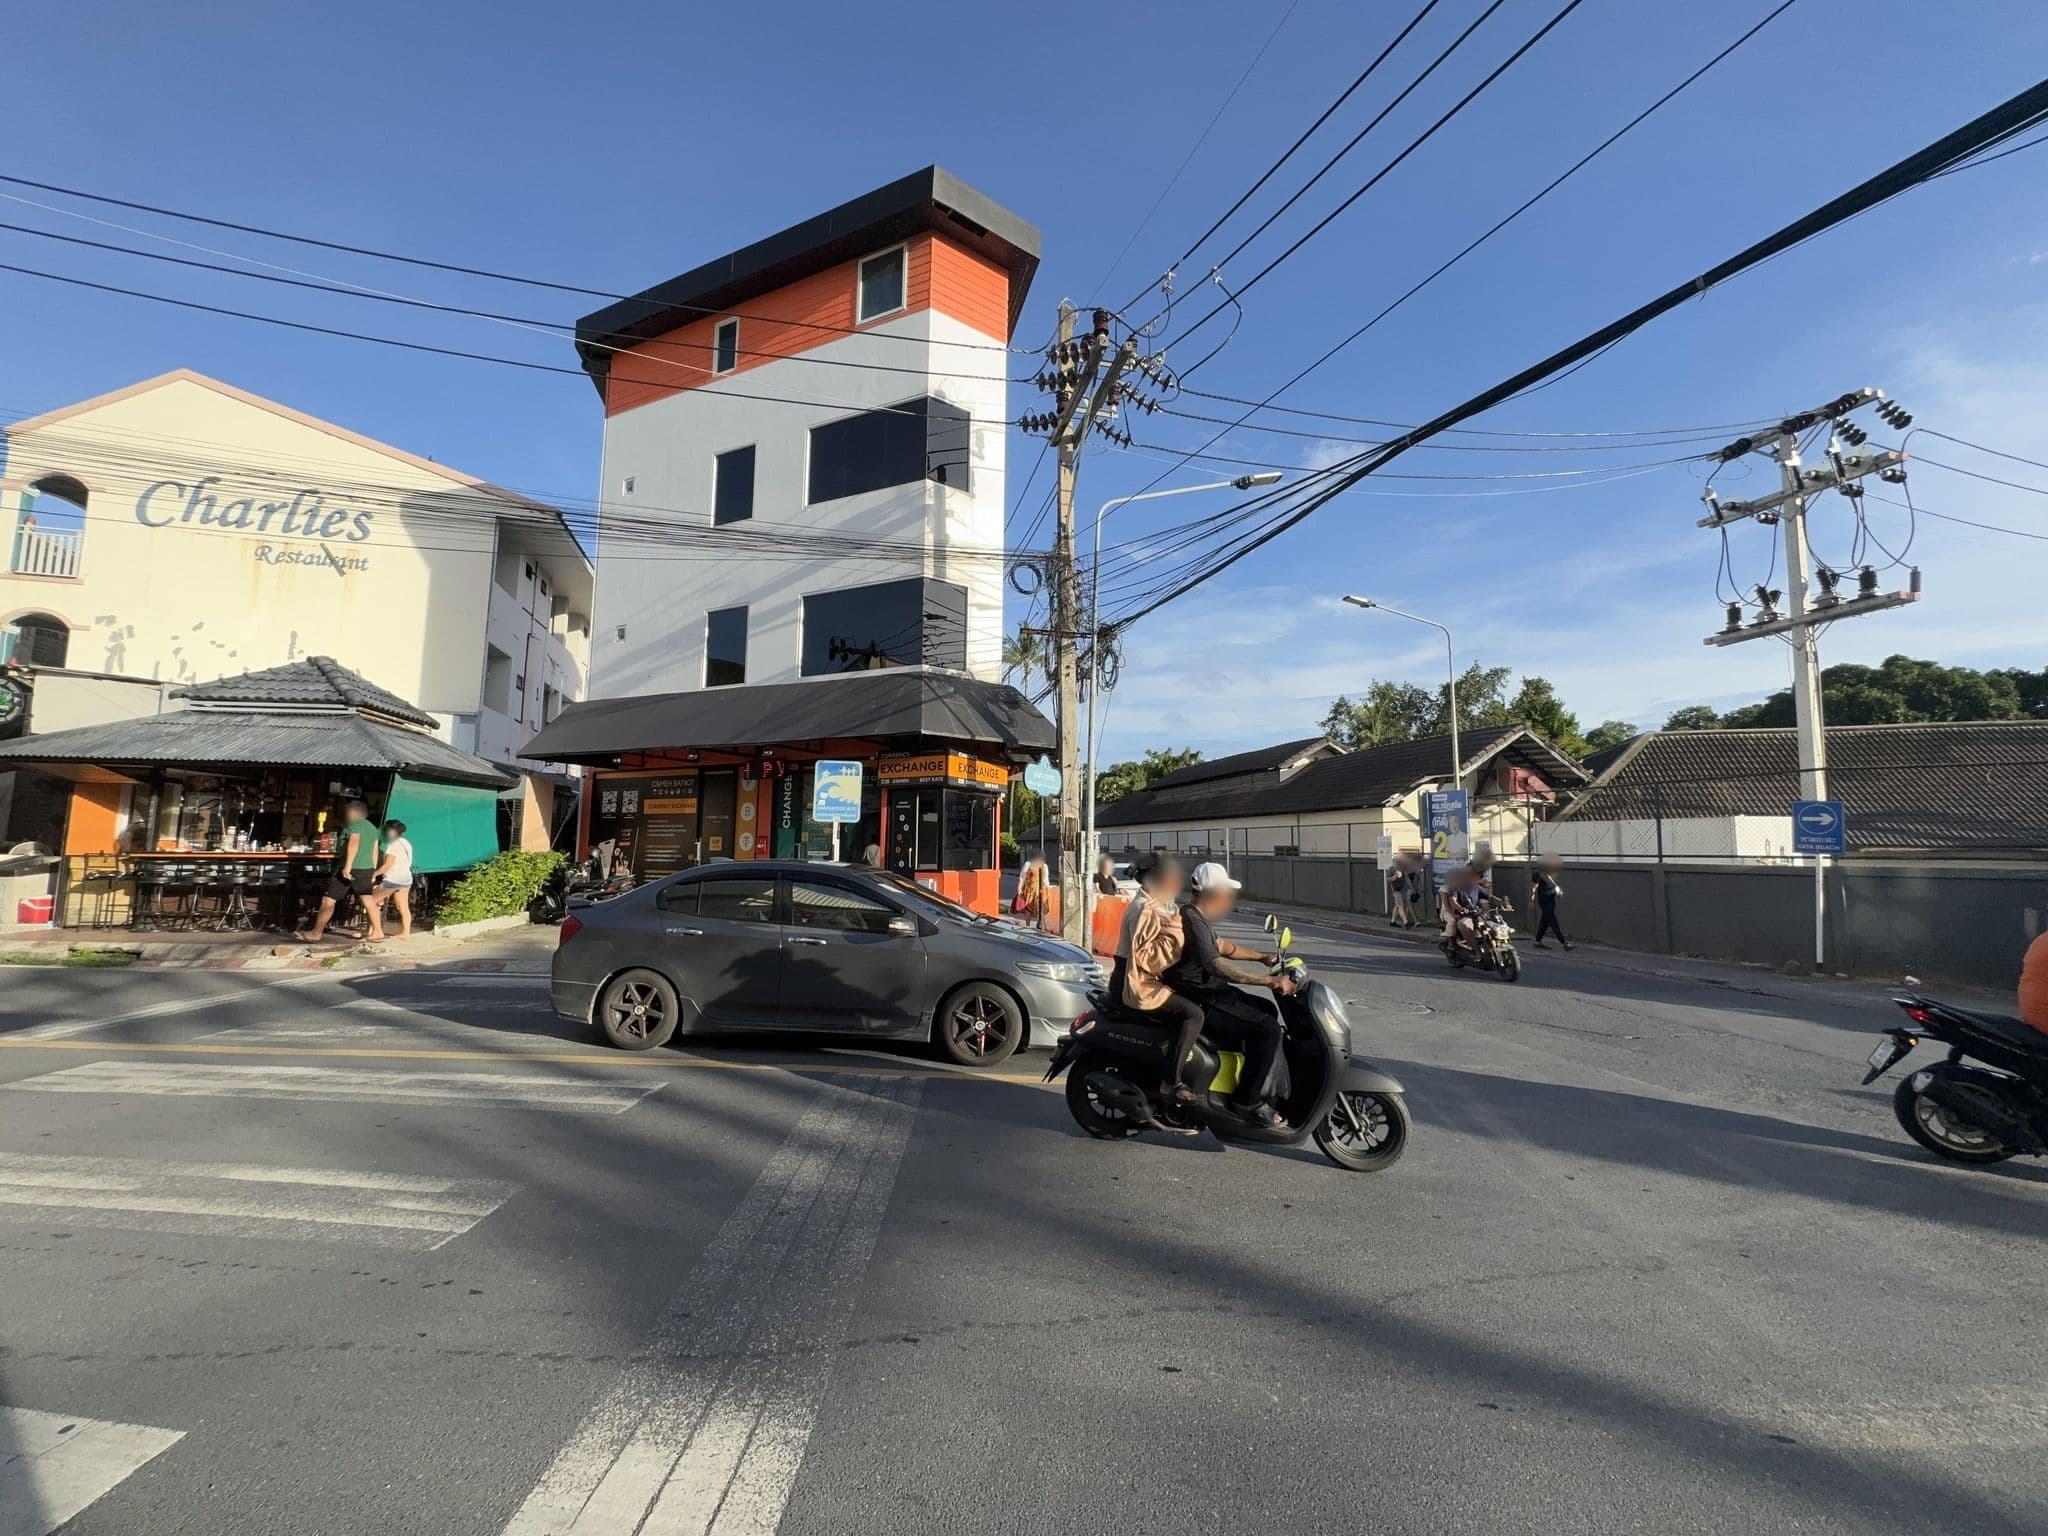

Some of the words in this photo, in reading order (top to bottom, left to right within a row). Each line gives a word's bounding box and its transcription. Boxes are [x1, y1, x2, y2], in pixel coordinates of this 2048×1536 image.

[135, 476, 374, 541] Charlies
[254, 545, 369, 571] Restaurant
[880, 761, 944, 774] EXCHANGE
[958, 762, 999, 779] EXCHANGE
[782, 775, 793, 829] CHANGE
[1433, 831, 1449, 859] 2
